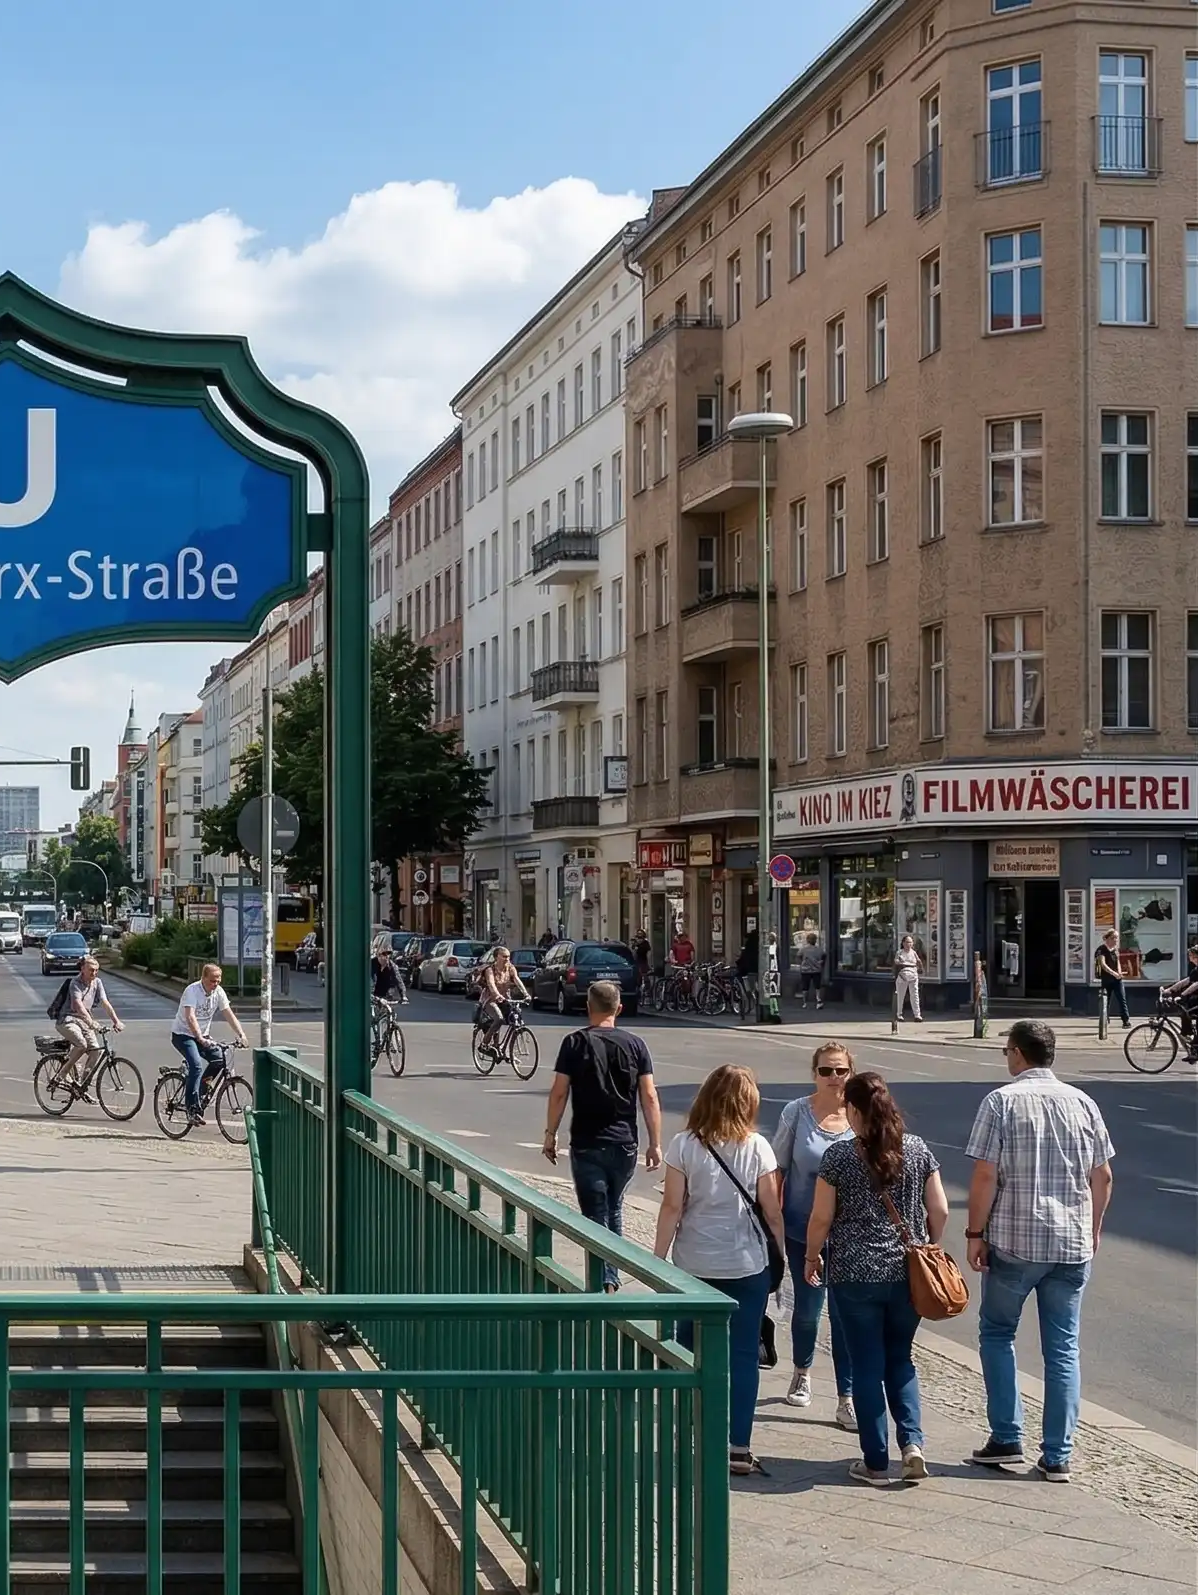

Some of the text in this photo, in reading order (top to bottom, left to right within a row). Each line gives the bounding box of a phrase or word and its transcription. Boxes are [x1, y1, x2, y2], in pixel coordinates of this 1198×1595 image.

[799, 785, 892, 827] KINO IM KIEZ
[923, 769, 1190, 813] FILMWÄSCHEREI
